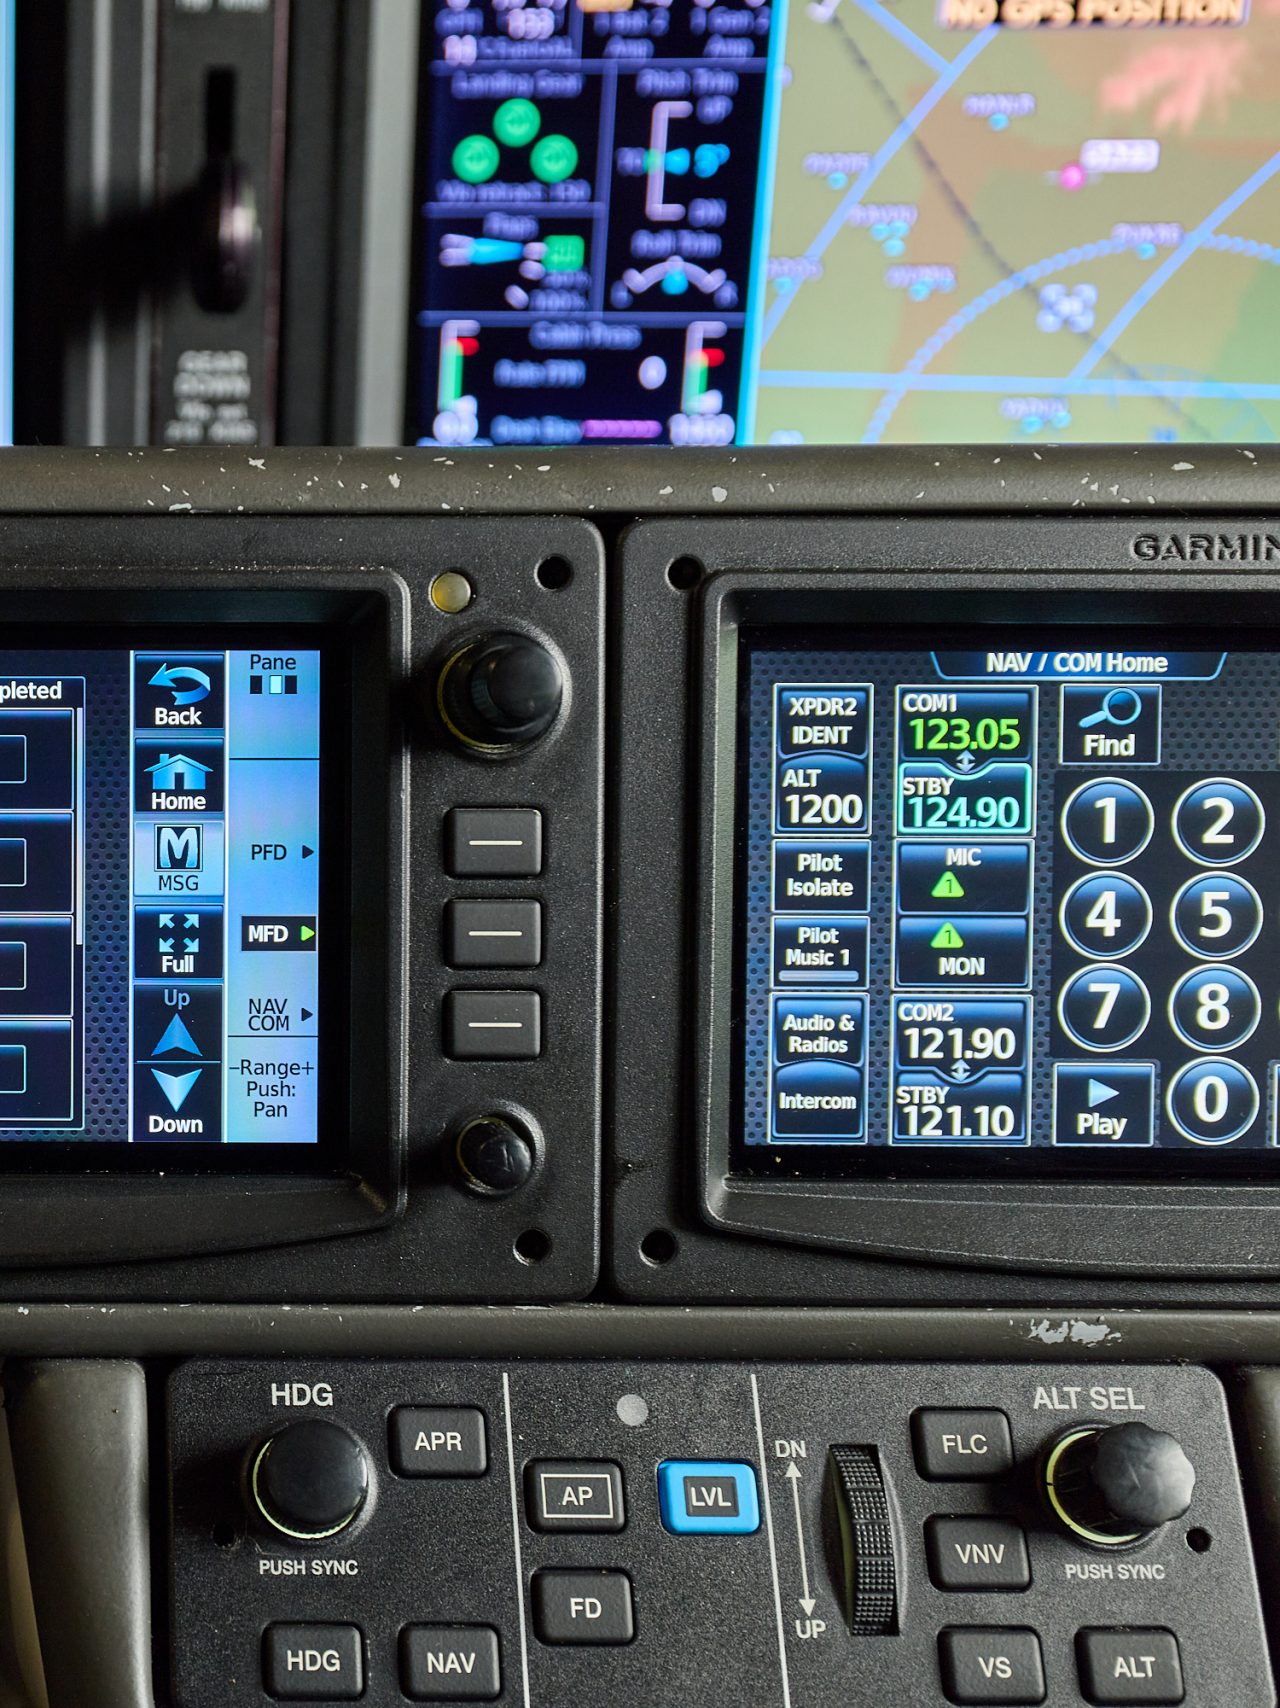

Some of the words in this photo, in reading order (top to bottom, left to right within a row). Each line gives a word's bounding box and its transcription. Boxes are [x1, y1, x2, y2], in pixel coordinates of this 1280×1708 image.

[249, 653, 297, 671] Pane
[986, 653, 1031, 673] NAV
[1038, 653, 1048, 674] /
[1053, 653, 1104, 673] COM
[1109, 653, 1168, 673] Home
[789, 697, 858, 717] XPDR2
[903, 693, 957, 713] COM1
[154, 707, 202, 725] Back
[792, 726, 853, 745] IDENT
[909, 718, 1021, 752] 123.05
[1084, 734, 1136, 758] Find
[782, 769, 822, 788] ALT
[902, 777, 954, 797] STBY
[151, 792, 207, 810] Home
[785, 793, 864, 825] 1200
[908, 797, 1021, 830] 124.90
[1095, 798, 1117, 844] 1
[1201, 798, 1235, 845] 2
[251, 844, 287, 861] PFD
[797, 853, 843, 873] Pilot
[946, 848, 982, 867] MIC
[158, 875, 199, 891] MSG
[786, 877, 854, 898] Isolate
[945, 878, 954, 895] 1
[1086, 891, 1121, 938] 4
[1199, 891, 1232, 939] 5
[248, 925, 289, 943] MFD
[797, 926, 840, 946] Pilot
[945, 929, 954, 946] 1
[161, 954, 195, 973] Full
[785, 948, 835, 967] Music
[840, 948, 851, 967] 1
[939, 957, 985, 977] MON
[164, 988, 191, 1010] Up
[248, 998, 288, 1015] NAV
[1088, 984, 1121, 1029] 7
[1197, 983, 1231, 1031] 8
[248, 1015, 290, 1032] COM
[783, 1012, 836, 1033] Audio
[840, 1012, 856, 1033] &
[898, 1003, 955, 1024] COM2
[788, 1035, 849, 1055] Radios
[904, 1027, 1017, 1061] 121.90
[247, 1080, 296, 1097] Push:
[897, 1086, 950, 1106] STBY
[1193, 1075, 1229, 1123] 0
[253, 1101, 288, 1118] Pan
[779, 1092, 857, 1111] Intercom
[148, 1115, 204, 1133] Down
[902, 1106, 1015, 1139] 121.10
[1077, 1113, 1129, 1141] Play
[269, 1383, 334, 1408] HDG
[1032, 1387, 1078, 1411] ALT
[1089, 1387, 1145, 1411] SEL
[414, 1430, 463, 1453] APR
[774, 1440, 807, 1459] DN
[940, 1432, 988, 1456] FLC
[560, 1487, 594, 1508] AP
[691, 1486, 732, 1509] LVL
[954, 1543, 1005, 1567] VNV
[258, 1559, 306, 1576] PUSH
[310, 1558, 360, 1576] SYNC
[1064, 1564, 1110, 1581] PUSH
[1114, 1564, 1166, 1581] SYNC
[570, 1597, 602, 1620] FD
[794, 1619, 827, 1641] UP
[286, 1649, 341, 1673] HDG
[426, 1651, 476, 1675] NAV
[977, 1657, 1012, 1679] VS
[1112, 1655, 1158, 1679] ALT
